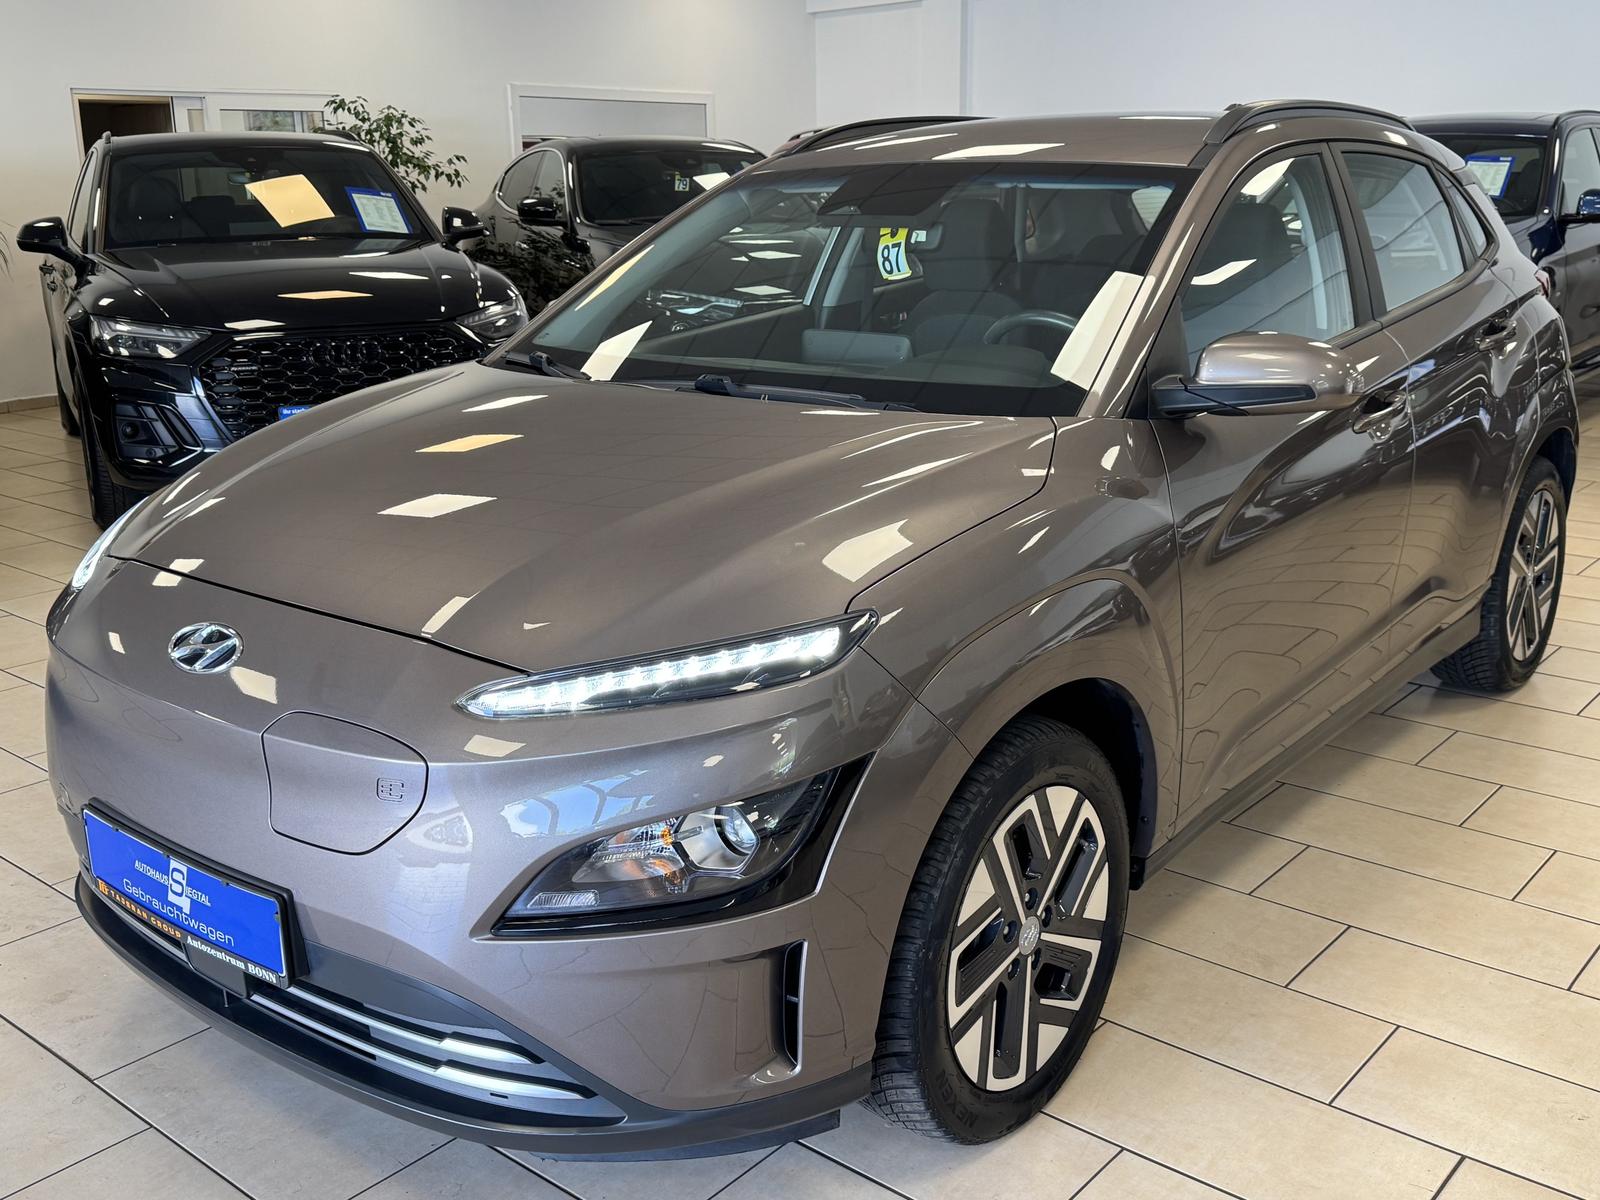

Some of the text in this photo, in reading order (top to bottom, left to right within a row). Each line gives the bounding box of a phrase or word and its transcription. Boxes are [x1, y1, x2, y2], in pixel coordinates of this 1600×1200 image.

[676, 178, 688, 190] 79
[881, 242, 902, 275] 87
[134, 860, 169, 887] AUTOHAUS
[123, 878, 235, 947] Gebrauchtwagen
[150, 917, 181, 938] GROUP
[186, 935, 277, 984] Autozentrum BONN
